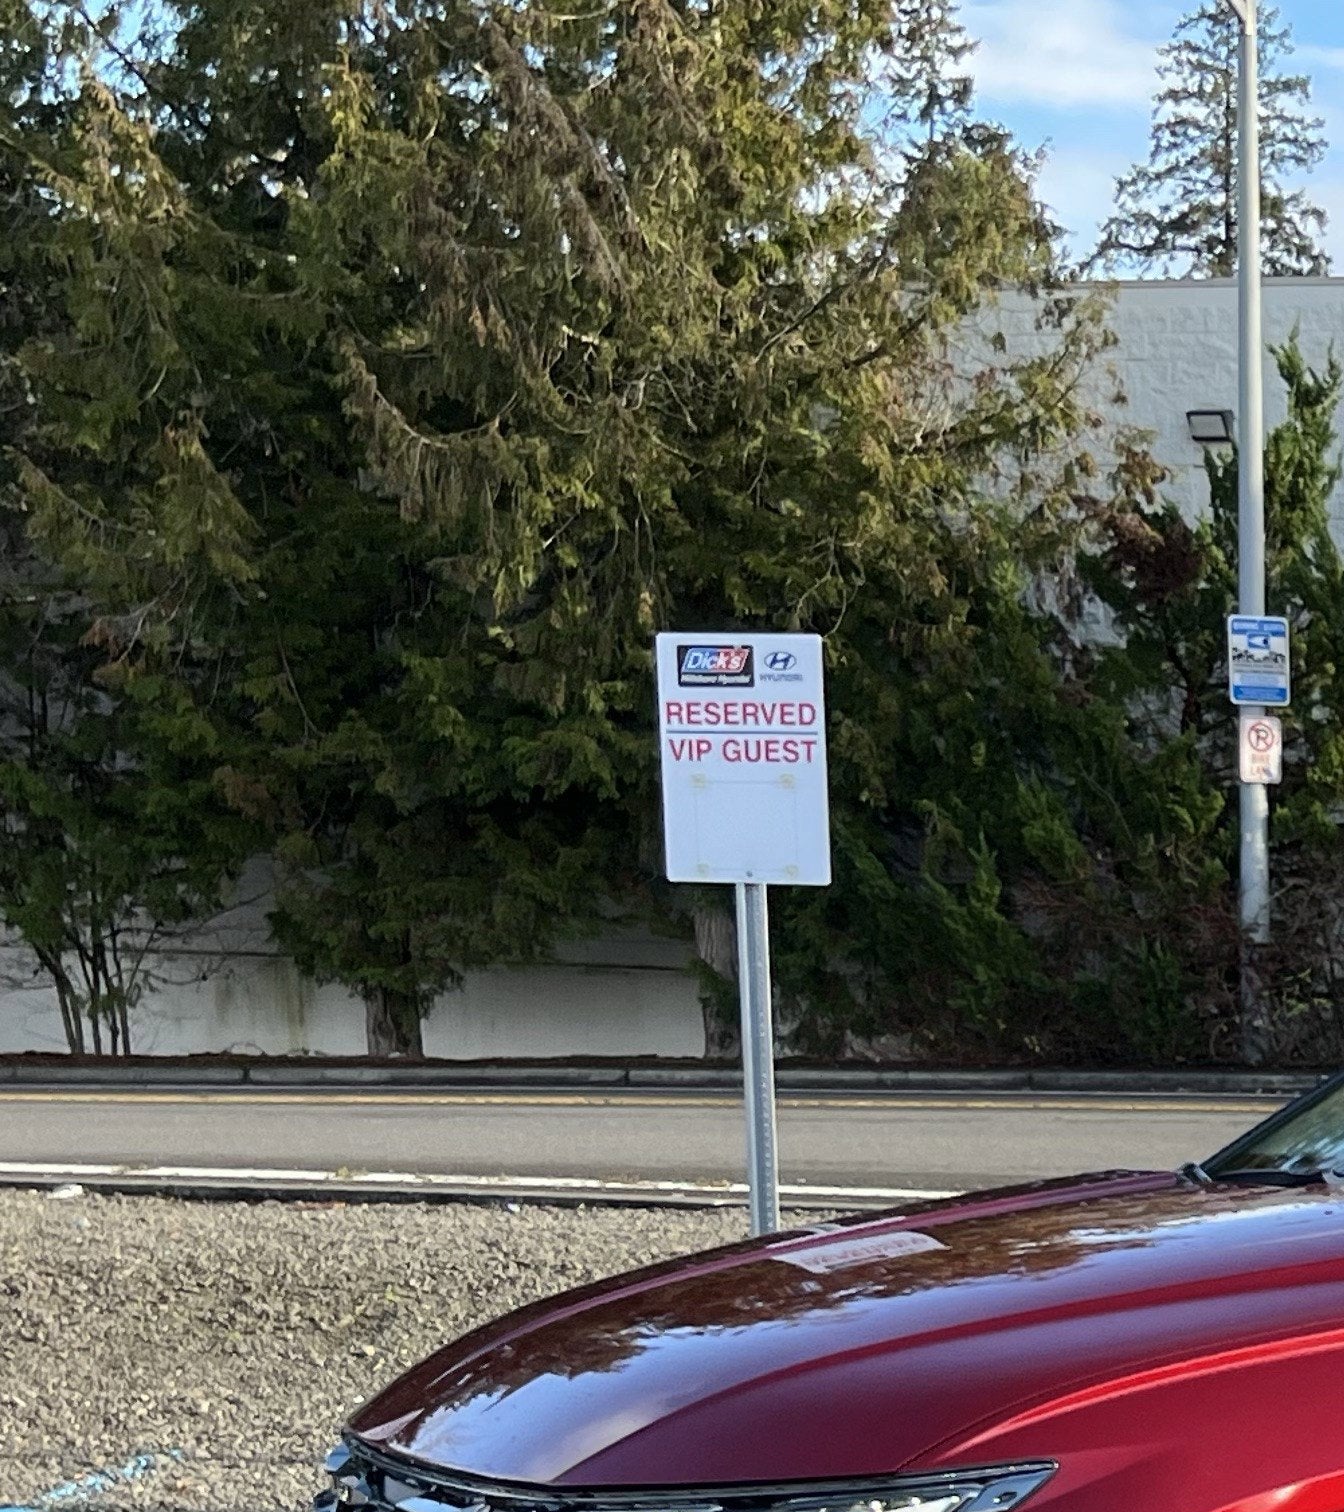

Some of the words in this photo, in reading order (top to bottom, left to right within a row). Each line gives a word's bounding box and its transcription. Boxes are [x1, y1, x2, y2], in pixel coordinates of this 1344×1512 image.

[687, 652, 742, 670] Dick's
[666, 702, 816, 726] RESERVED
[669, 738, 712, 762] VIP
[722, 739, 817, 763] GUEST
